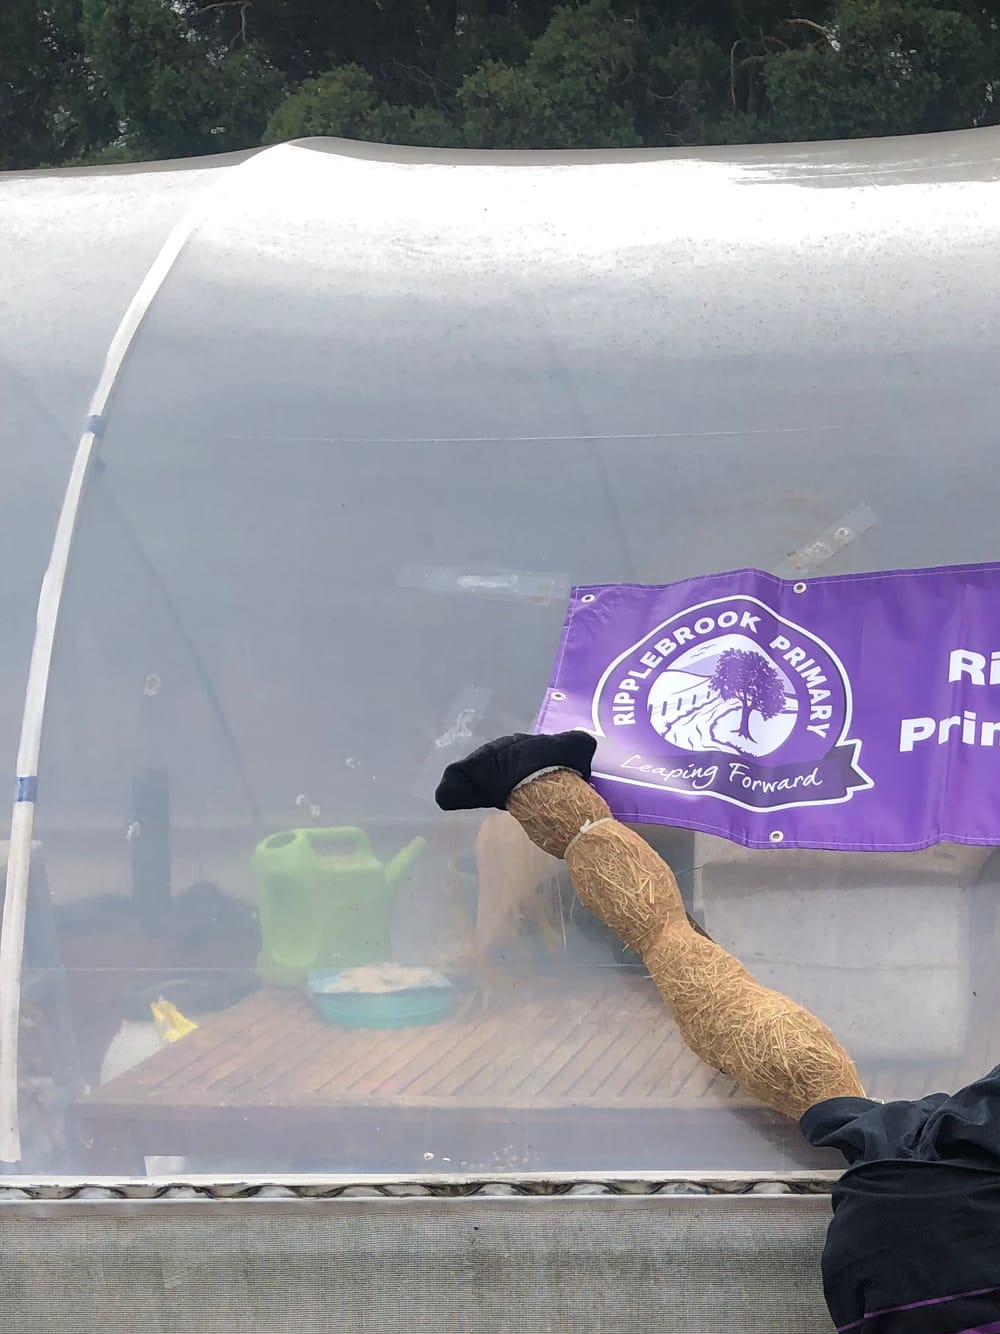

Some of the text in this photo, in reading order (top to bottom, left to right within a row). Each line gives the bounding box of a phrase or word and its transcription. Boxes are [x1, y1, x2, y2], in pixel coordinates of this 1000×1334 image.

[612, 611, 832, 738] RIPPLEBROOK PRIMARY
[620, 755, 823, 793] Leaping Forward
